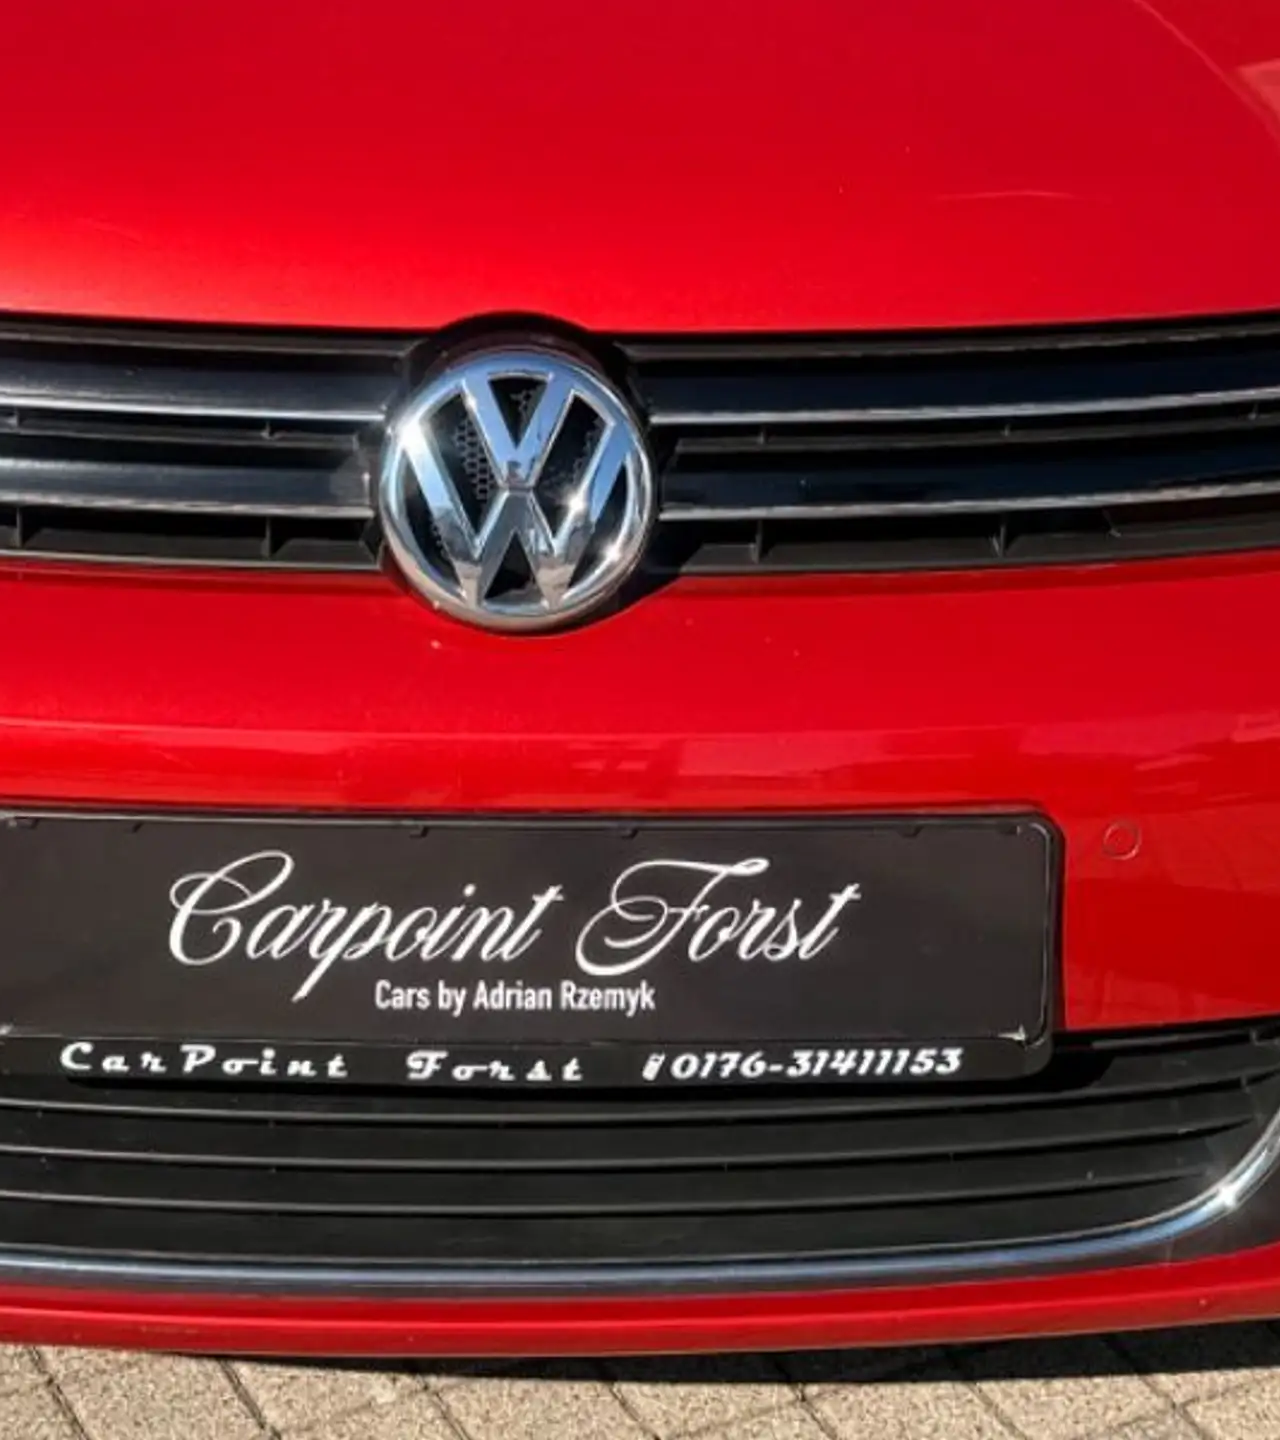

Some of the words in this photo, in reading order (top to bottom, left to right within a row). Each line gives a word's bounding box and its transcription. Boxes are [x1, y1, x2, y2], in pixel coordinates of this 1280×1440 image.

[169, 850, 565, 1002] Carpoint
[575, 857, 862, 976] Forst
[375, 979, 431, 1010] Cars
[438, 979, 467, 1018] by
[473, 979, 554, 1010] Adrian
[560, 979, 657, 1018] Rzemyk
[60, 1042, 348, 1078] CarPoint
[406, 1050, 582, 1082] Forst
[670, 1047, 963, 1079] 0176-31411153
